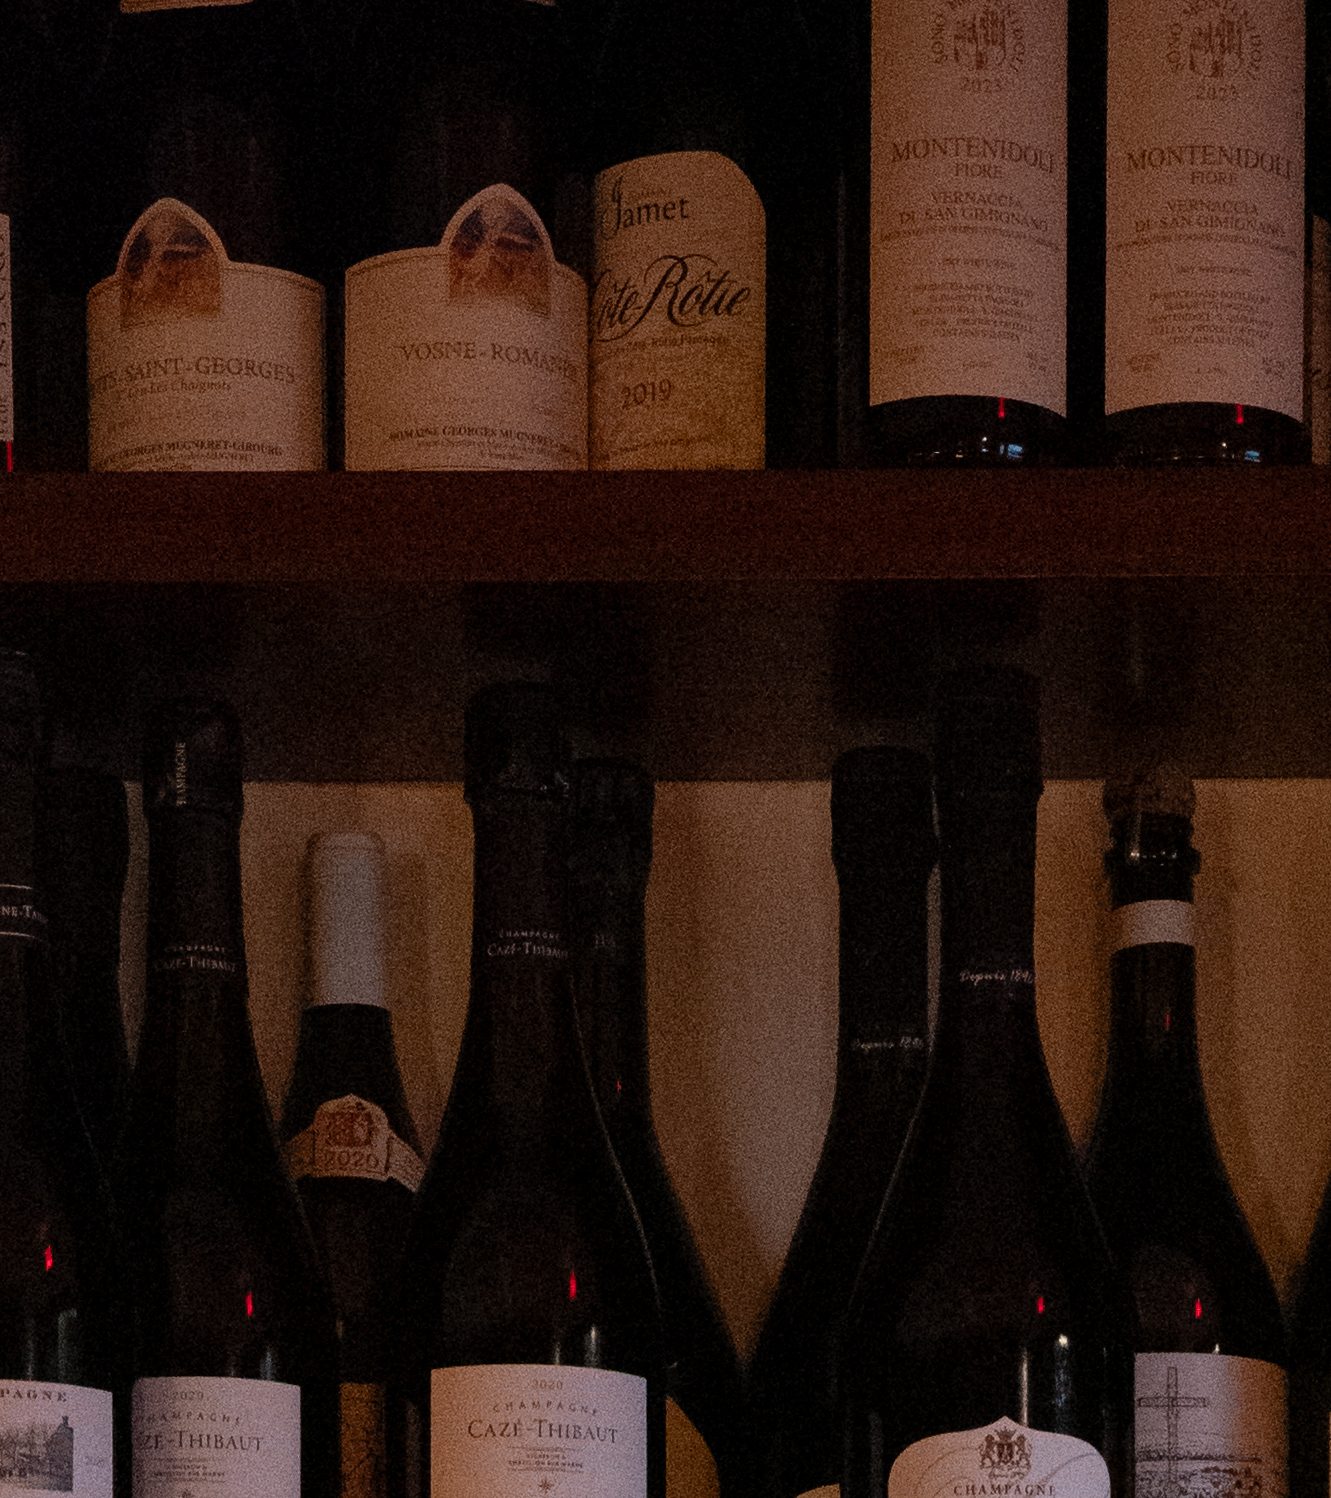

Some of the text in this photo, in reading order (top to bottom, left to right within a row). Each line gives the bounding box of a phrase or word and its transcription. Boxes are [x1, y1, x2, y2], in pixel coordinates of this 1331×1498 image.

[891, 137, 1054, 174] MONTENIDOLI
[1126, 145, 1291, 180] MONTENIDOLI
[324, 1150, 379, 1168] 2020
[493, 1400, 599, 1417] CHAMPAGNE
[953, 1484, 1057, 1497] CHAMPAGNE
